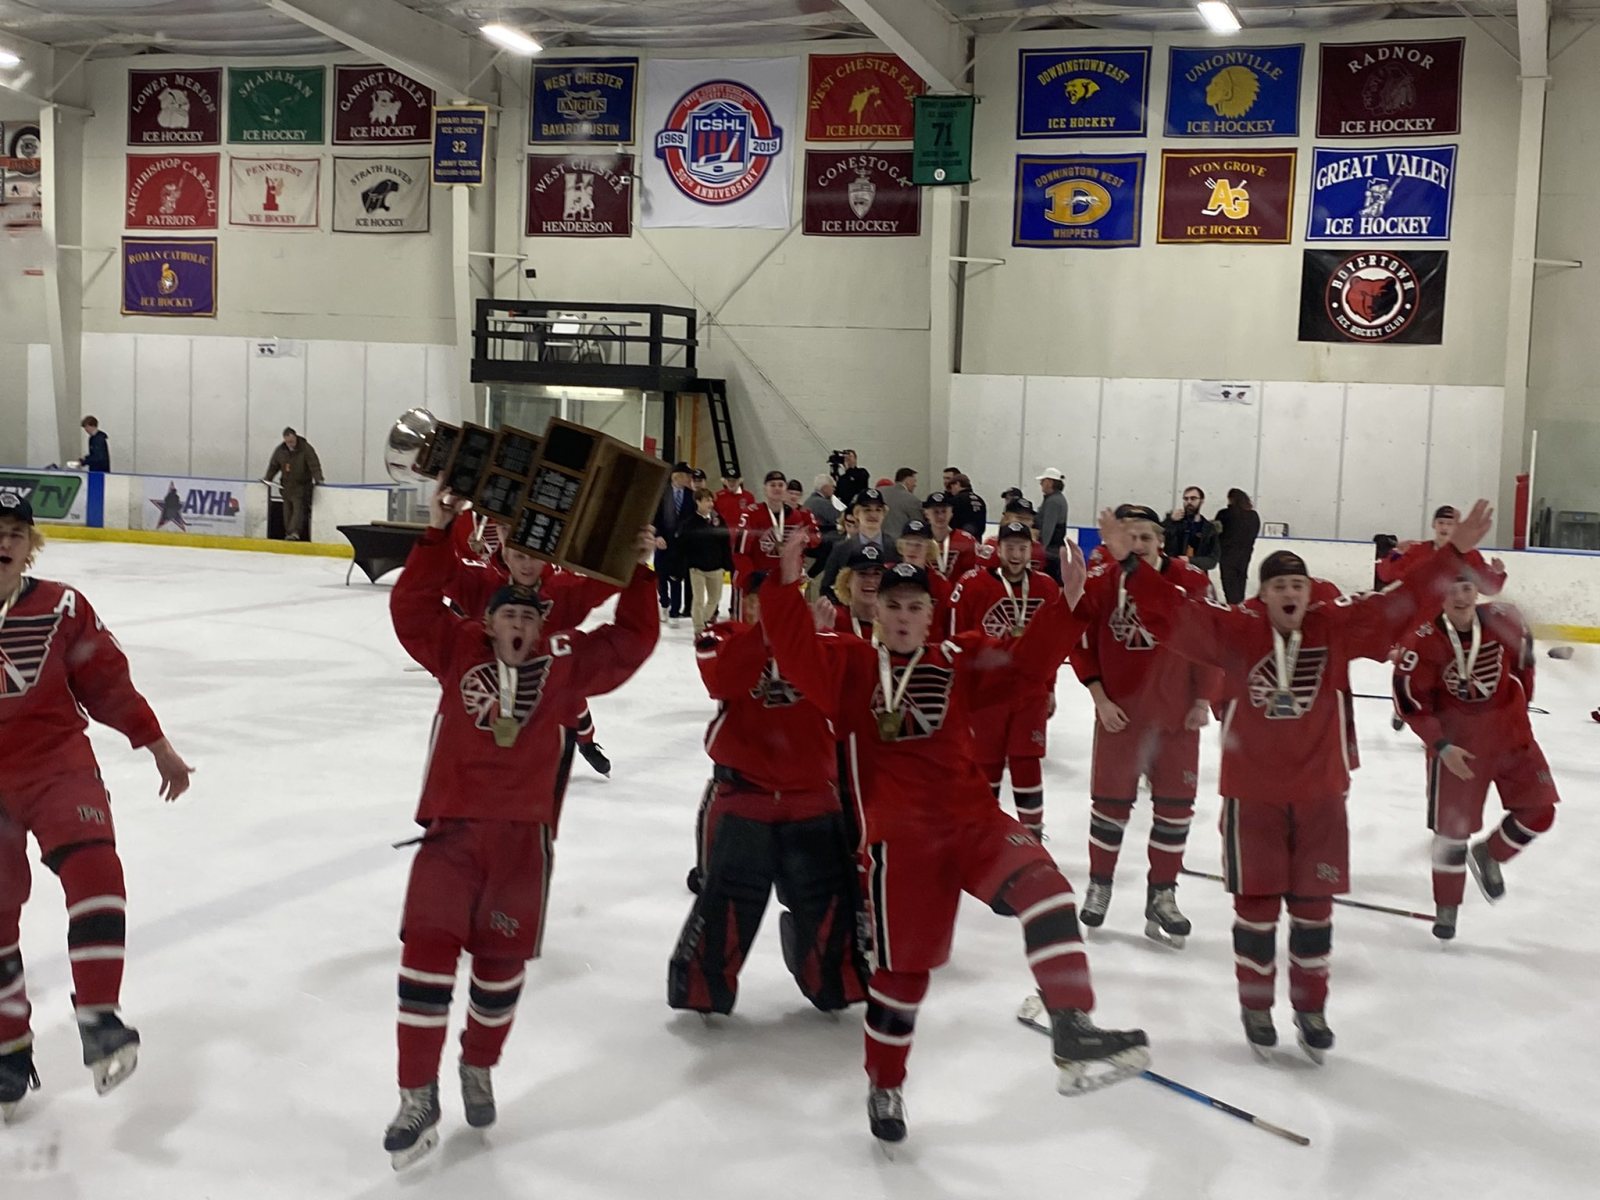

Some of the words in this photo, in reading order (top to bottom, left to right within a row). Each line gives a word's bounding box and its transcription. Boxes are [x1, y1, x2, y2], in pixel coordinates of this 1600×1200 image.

[1185, 52, 1284, 82] UNIONVILLE
[1348, 46, 1434, 74] RADNOR
[1036, 59, 1106, 86] DOWNINGTOWN
[1106, 64, 1130, 84] EAST
[238, 70, 314, 98] SHANAHAN
[544, 73, 572, 92] WEST
[574, 72, 624, 89] CHESTER
[810, 76, 834, 110] WEST
[836, 58, 899, 78] CHESTER
[133, 78, 168, 114] LOWER
[175, 74, 216, 114] MERION
[340, 72, 384, 112] GARNET
[387, 72, 427, 109] VALLEY
[560, 100, 606, 112] KNIGHTS
[350, 126, 368, 138] ICE
[371, 125, 416, 137] HOCKEY
[581, 124, 620, 136] USTIN
[695, 120, 744, 130] ICSHL
[826, 125, 846, 136] ICE
[850, 124, 902, 136] HOCKEY
[1048, 118, 1066, 128] ICE
[1070, 117, 1116, 128] HOCKEY
[1186, 121, 1210, 133] ICE
[1214, 120, 1276, 132] HOCKEY
[1340, 120, 1366, 134] ICE
[1370, 118, 1436, 132] HOCKEY
[142, 132, 160, 142] ICE
[162, 131, 204, 142] HOCKEY
[242, 130, 260, 140] ICE
[262, 130, 308, 140] HOCKEY
[660, 134, 684, 144] 1969
[932, 122, 952, 147] 71
[452, 140, 467, 154] 32
[753, 141, 778, 152] 2019
[350, 164, 382, 186] STRATH
[1188, 162, 1222, 177] AVON
[1224, 161, 1268, 177] GROVE
[1316, 154, 1378, 190] GREAT
[1386, 153, 1449, 189] VALLEY
[127, 158, 181, 216] ARCHBISHOP
[182, 160, 217, 216] CARROLL
[534, 163, 566, 194] WEST
[694, 168, 758, 199] ANNIVERSARY
[1100, 170, 1124, 188] WEST
[1207, 179, 1250, 220] AG
[146, 216, 196, 226] PATRIOTS
[356, 218, 369, 226] ICE
[371, 218, 404, 227] HOCKEY
[542, 221, 613, 232] HENDERSON
[822, 220, 842, 232] ICE
[846, 220, 899, 232] HOCKEY
[1324, 218, 1354, 234] ICE
[1360, 216, 1432, 234] HOCKEY
[1054, 228, 1099, 238] WHIPPETS
[1187, 226, 1208, 236] ICE
[1210, 226, 1261, 236] HOCKEY
[128, 252, 162, 265] ROMAN
[1332, 255, 1415, 290] BOYERTOWN
[1384, 315, 1406, 333] CLUB
[40, 486, 72, 508] TV
[182, 489, 235, 516] AYHL
[950, 583, 964, 602] 6
[54, 589, 76, 618] A
[550, 634, 572, 656] C
